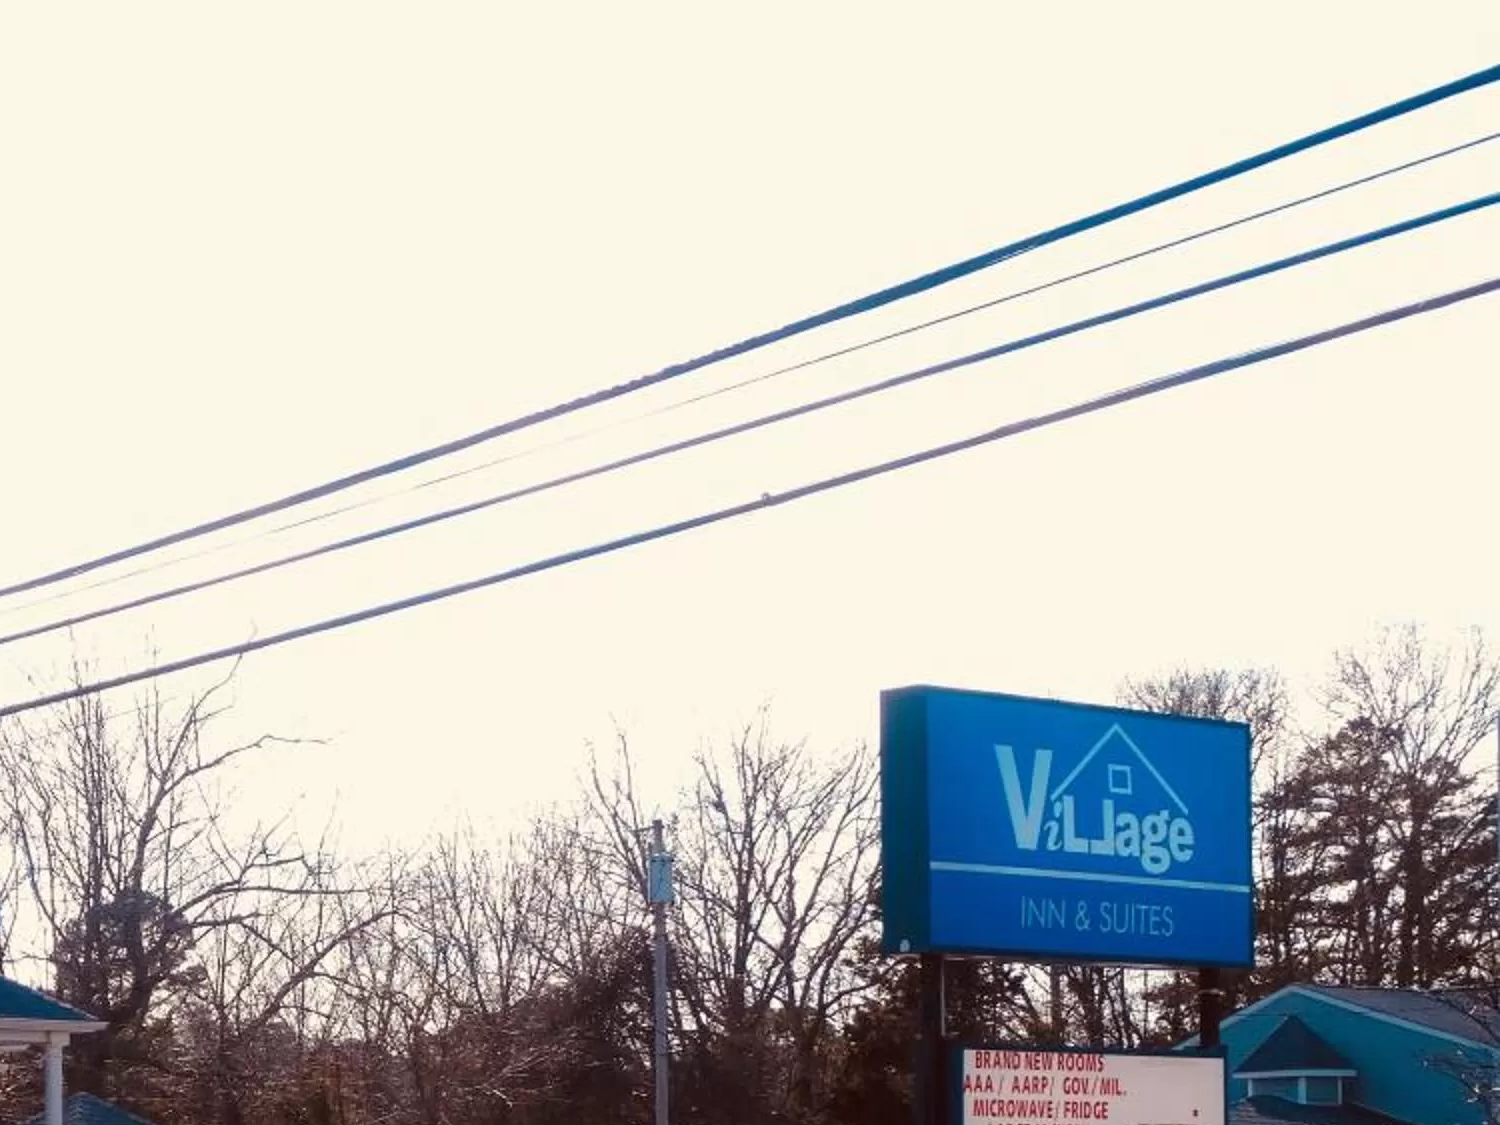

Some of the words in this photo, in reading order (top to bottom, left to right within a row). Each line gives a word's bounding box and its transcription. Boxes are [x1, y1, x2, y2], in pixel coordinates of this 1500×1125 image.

[1021, 896, 1065, 928] INN
[1075, 900, 1090, 931] &
[1100, 902, 1174, 937] SUITES
[975, 1051, 1020, 1069] BRAND
[1025, 1053, 1052, 1070] NEW
[1057, 1054, 1104, 1072] ROOMS
[964, 1074, 993, 1093] AAA
[1064, 1101, 1108, 1119] FRIDGE
